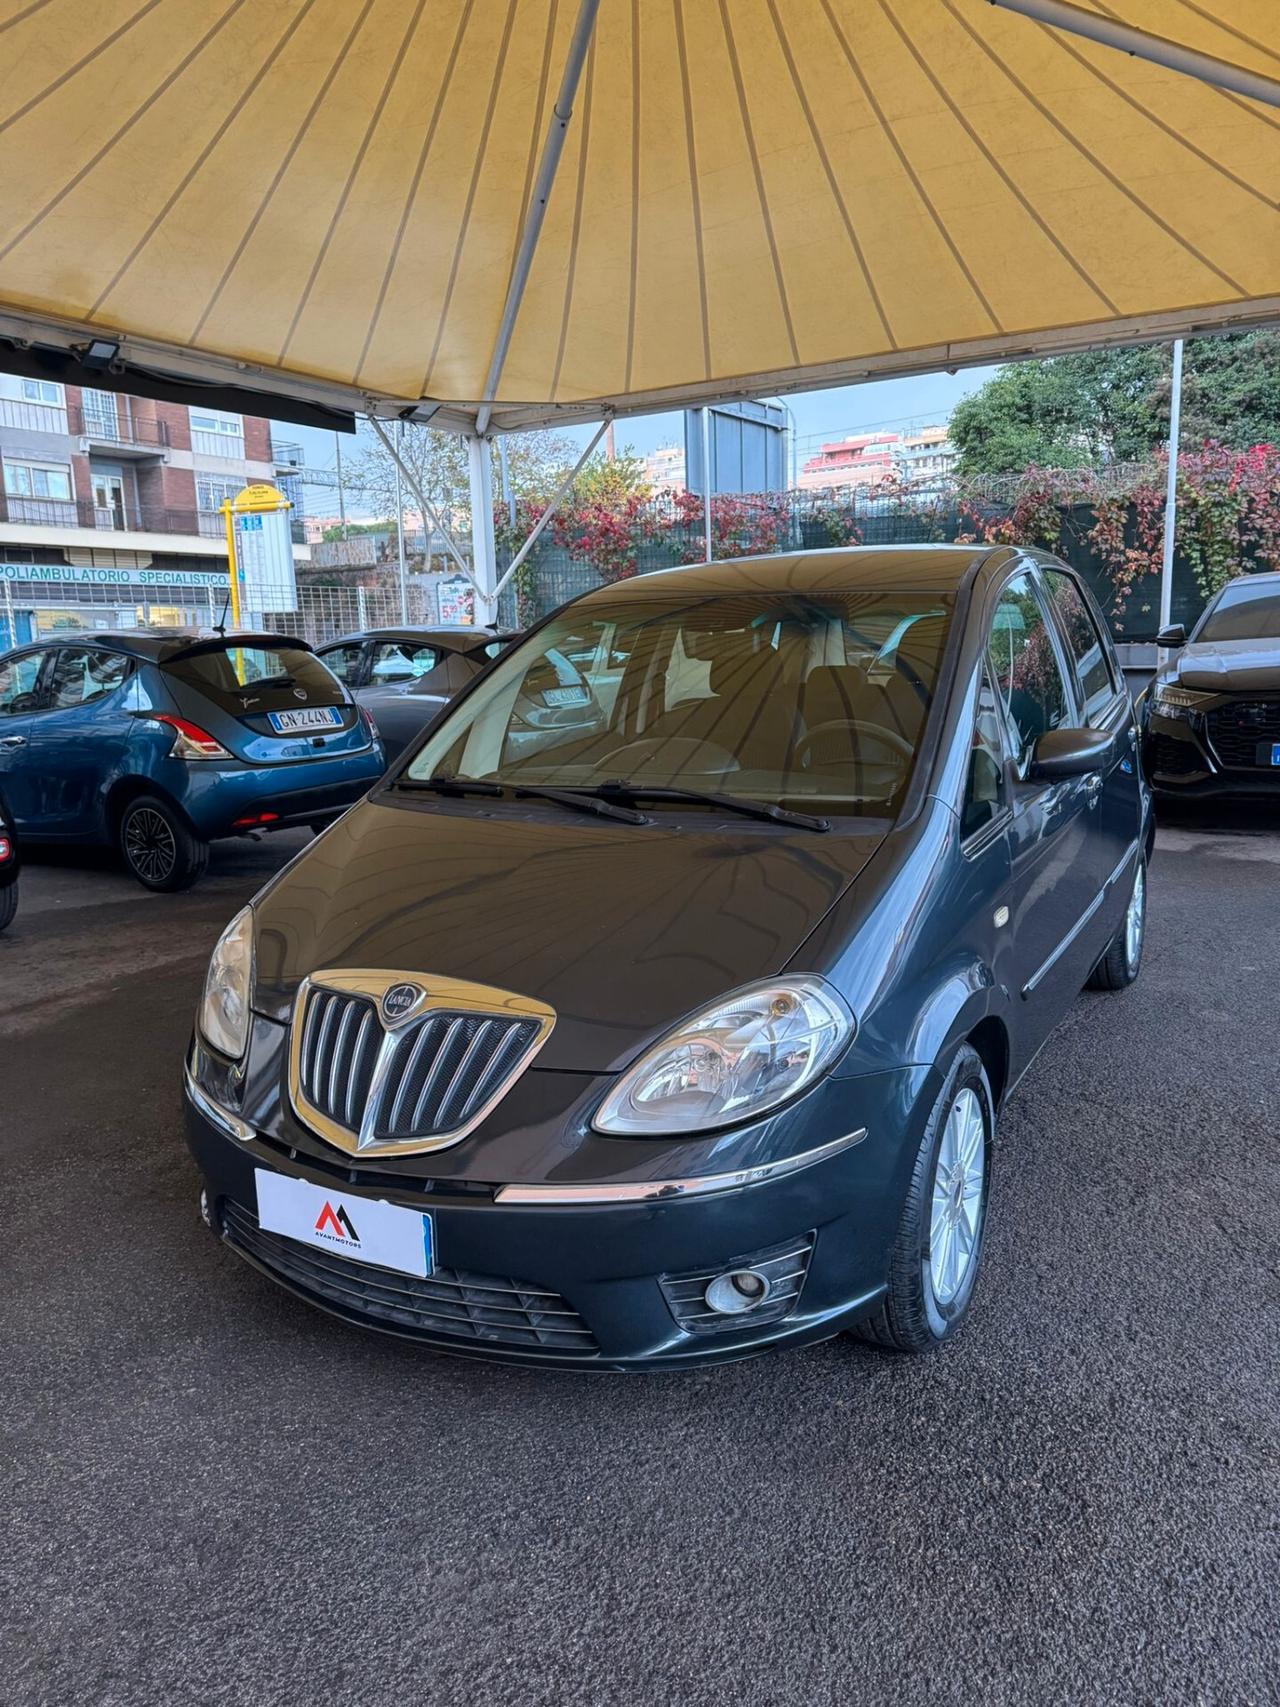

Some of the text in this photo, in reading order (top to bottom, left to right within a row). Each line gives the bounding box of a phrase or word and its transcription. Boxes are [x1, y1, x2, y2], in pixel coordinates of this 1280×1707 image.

[139, 571, 227, 586] SPECIALISTICO
[388, 993, 412, 1006] LANCIA
[315, 1231, 362, 1249] AVANTMOTORS
